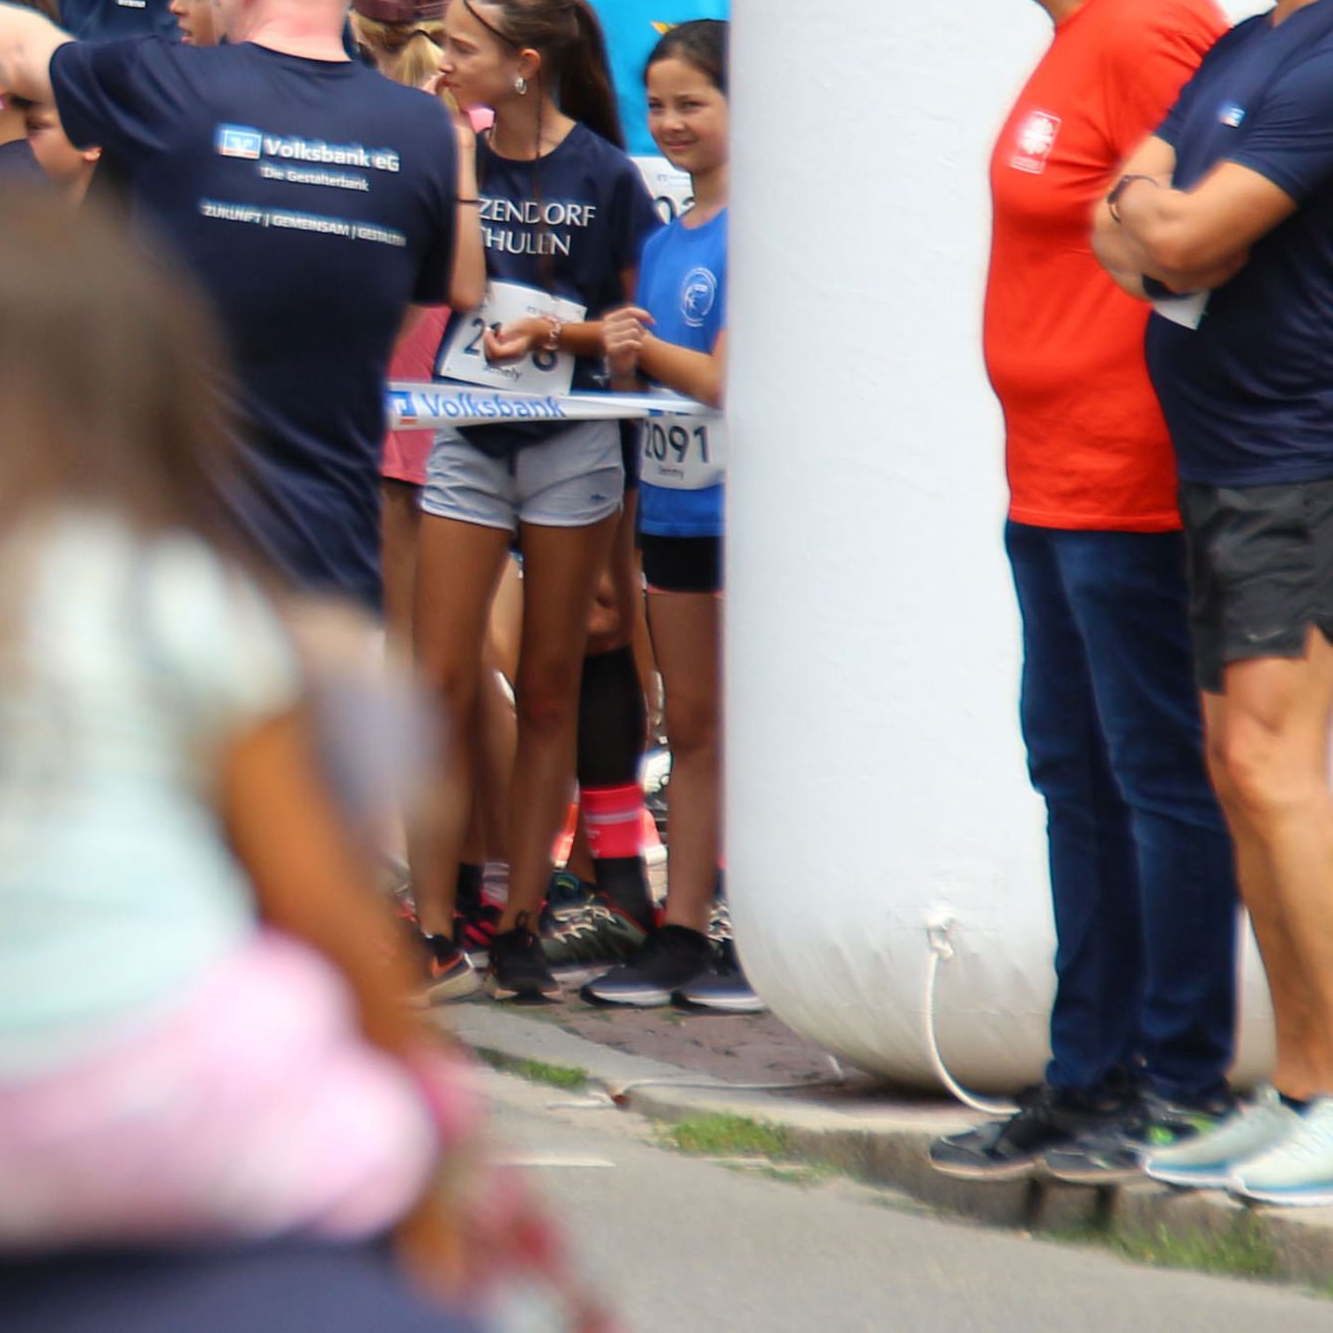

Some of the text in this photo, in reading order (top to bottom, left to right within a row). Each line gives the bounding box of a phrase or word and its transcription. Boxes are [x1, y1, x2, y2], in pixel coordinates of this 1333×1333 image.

[263, 137, 401, 173] Volksbank eG
[261, 166, 370, 192] Die Gestalterbank
[272, 214, 350, 236] GEMEINSAM
[482, 226, 571, 256] HULEN
[418, 393, 567, 419] Volksbank
